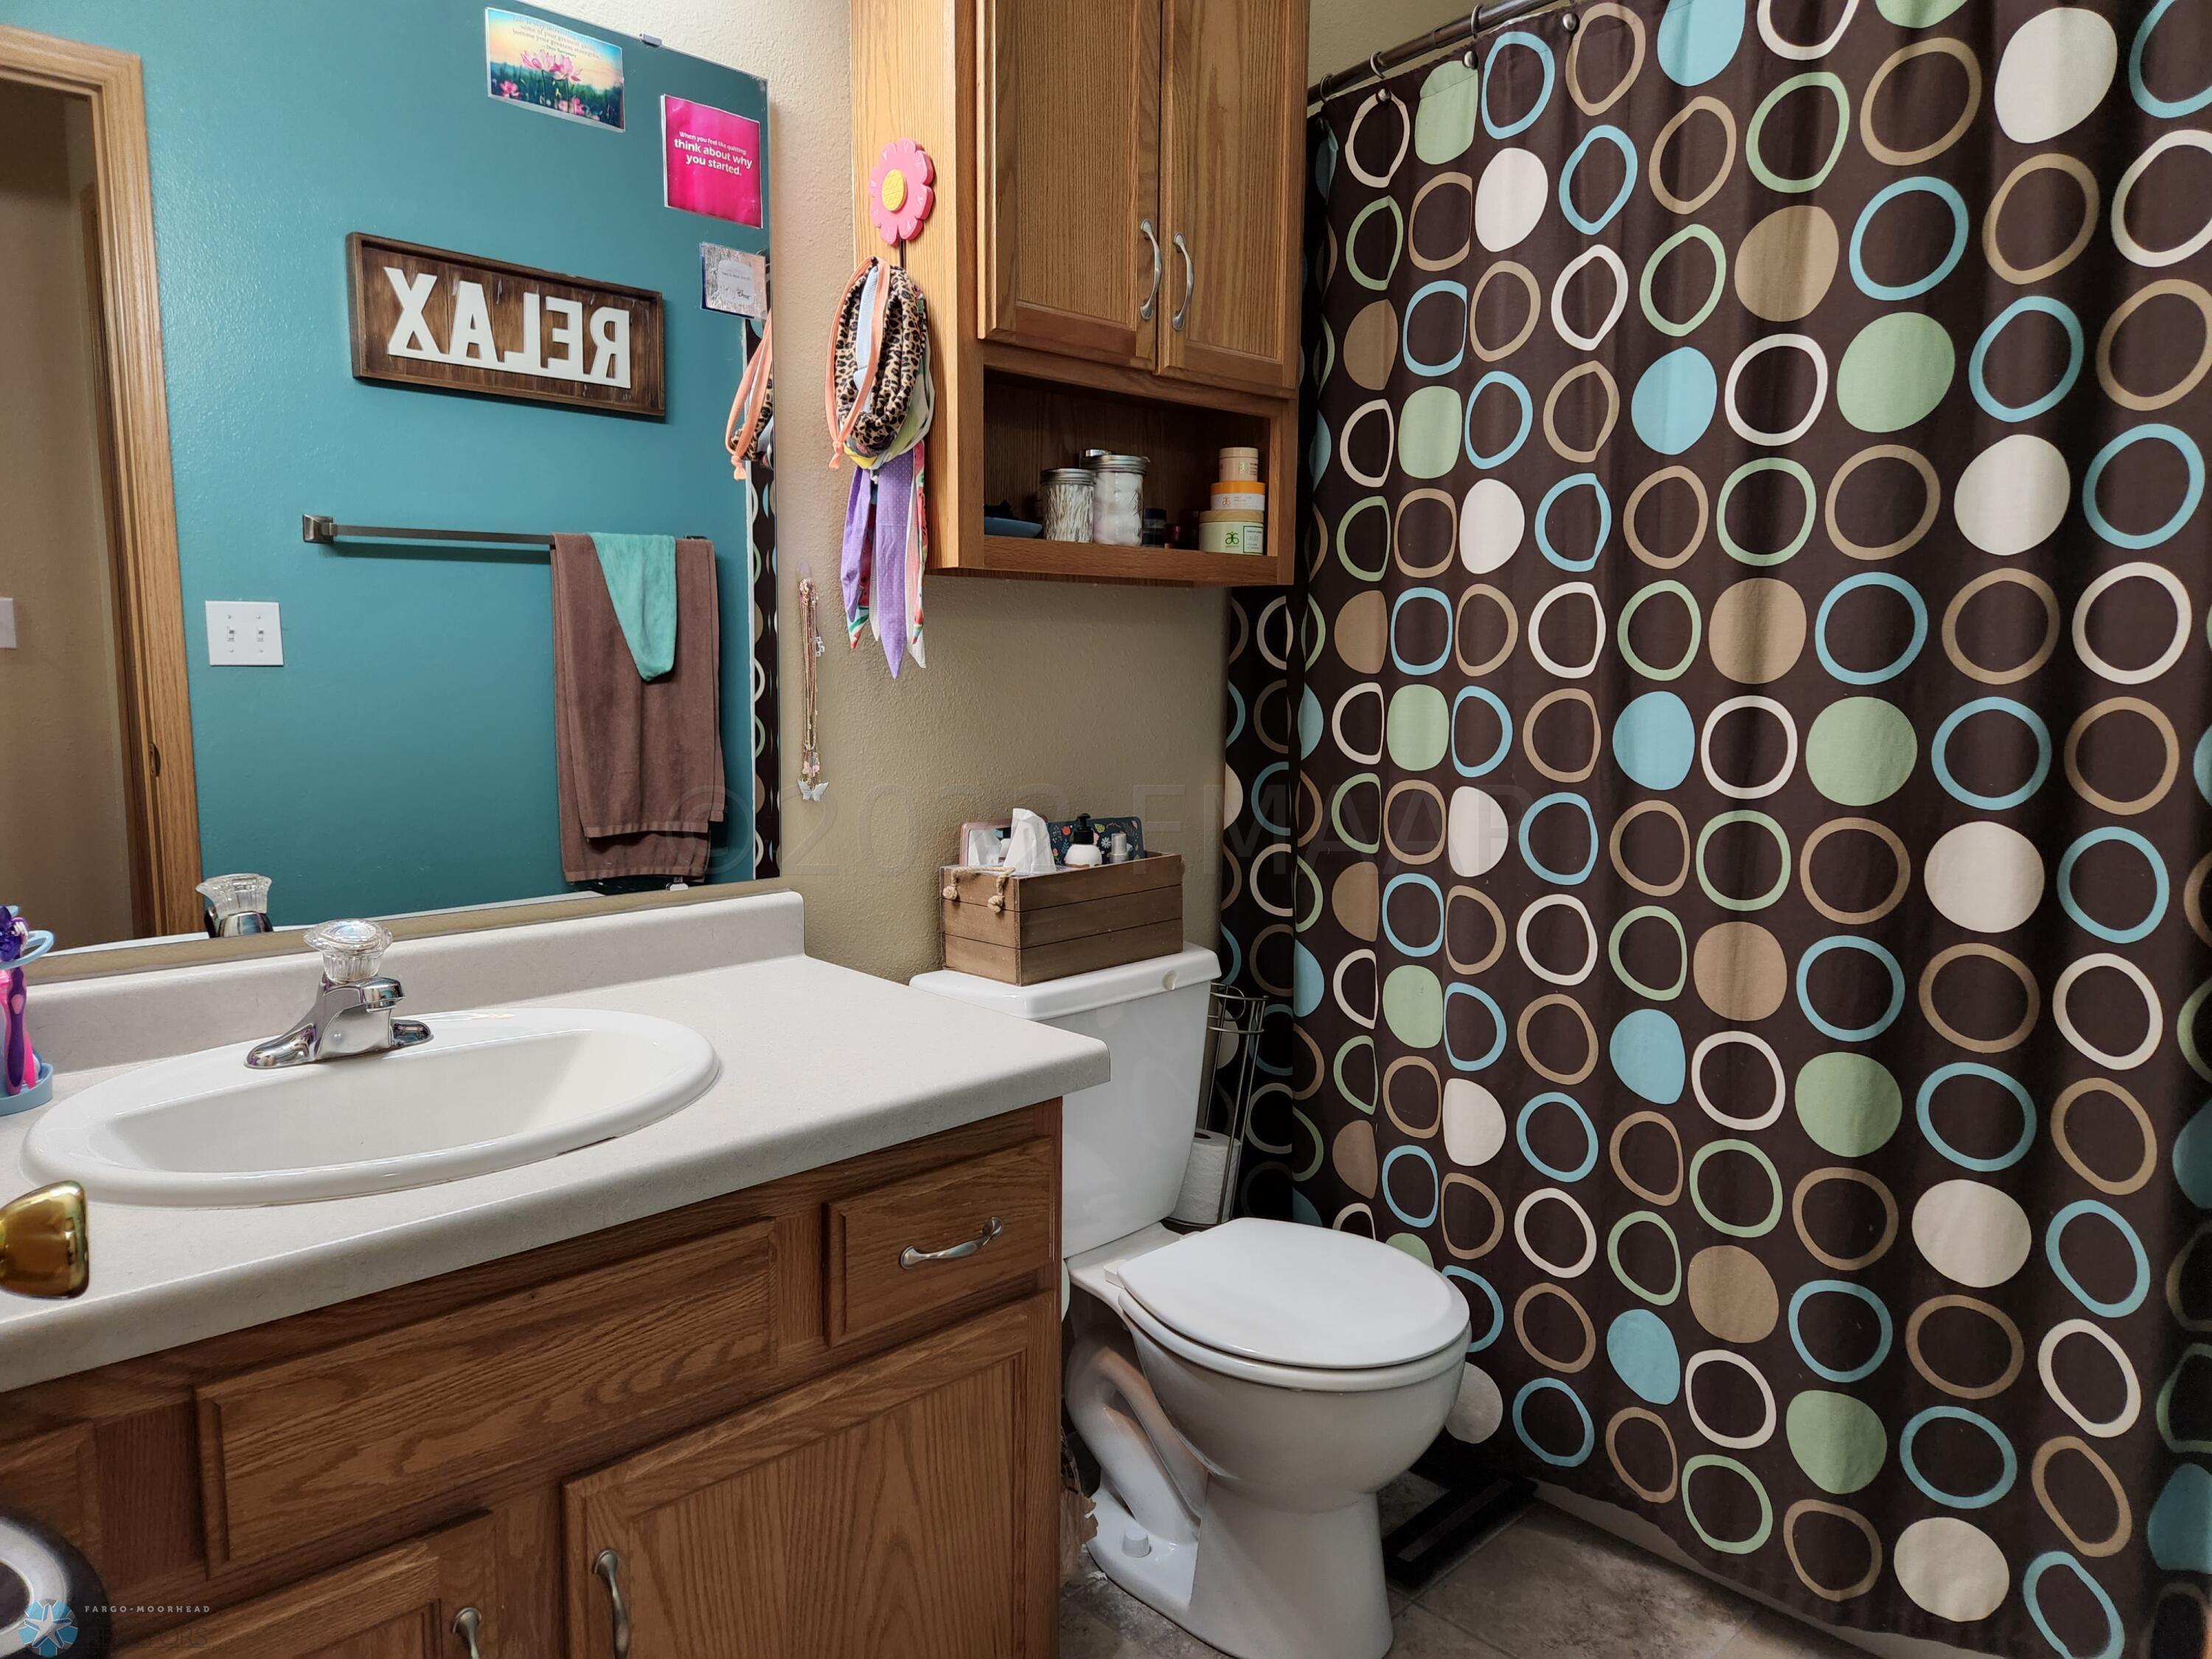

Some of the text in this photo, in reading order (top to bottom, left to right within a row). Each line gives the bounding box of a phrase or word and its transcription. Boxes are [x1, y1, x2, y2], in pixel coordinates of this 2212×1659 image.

[513, 27, 535, 39] become
[536, 35, 549, 44] your
[551, 40, 573, 51] greatest
[674, 138, 752, 169] think about why
[686, 153, 742, 175] you started.
